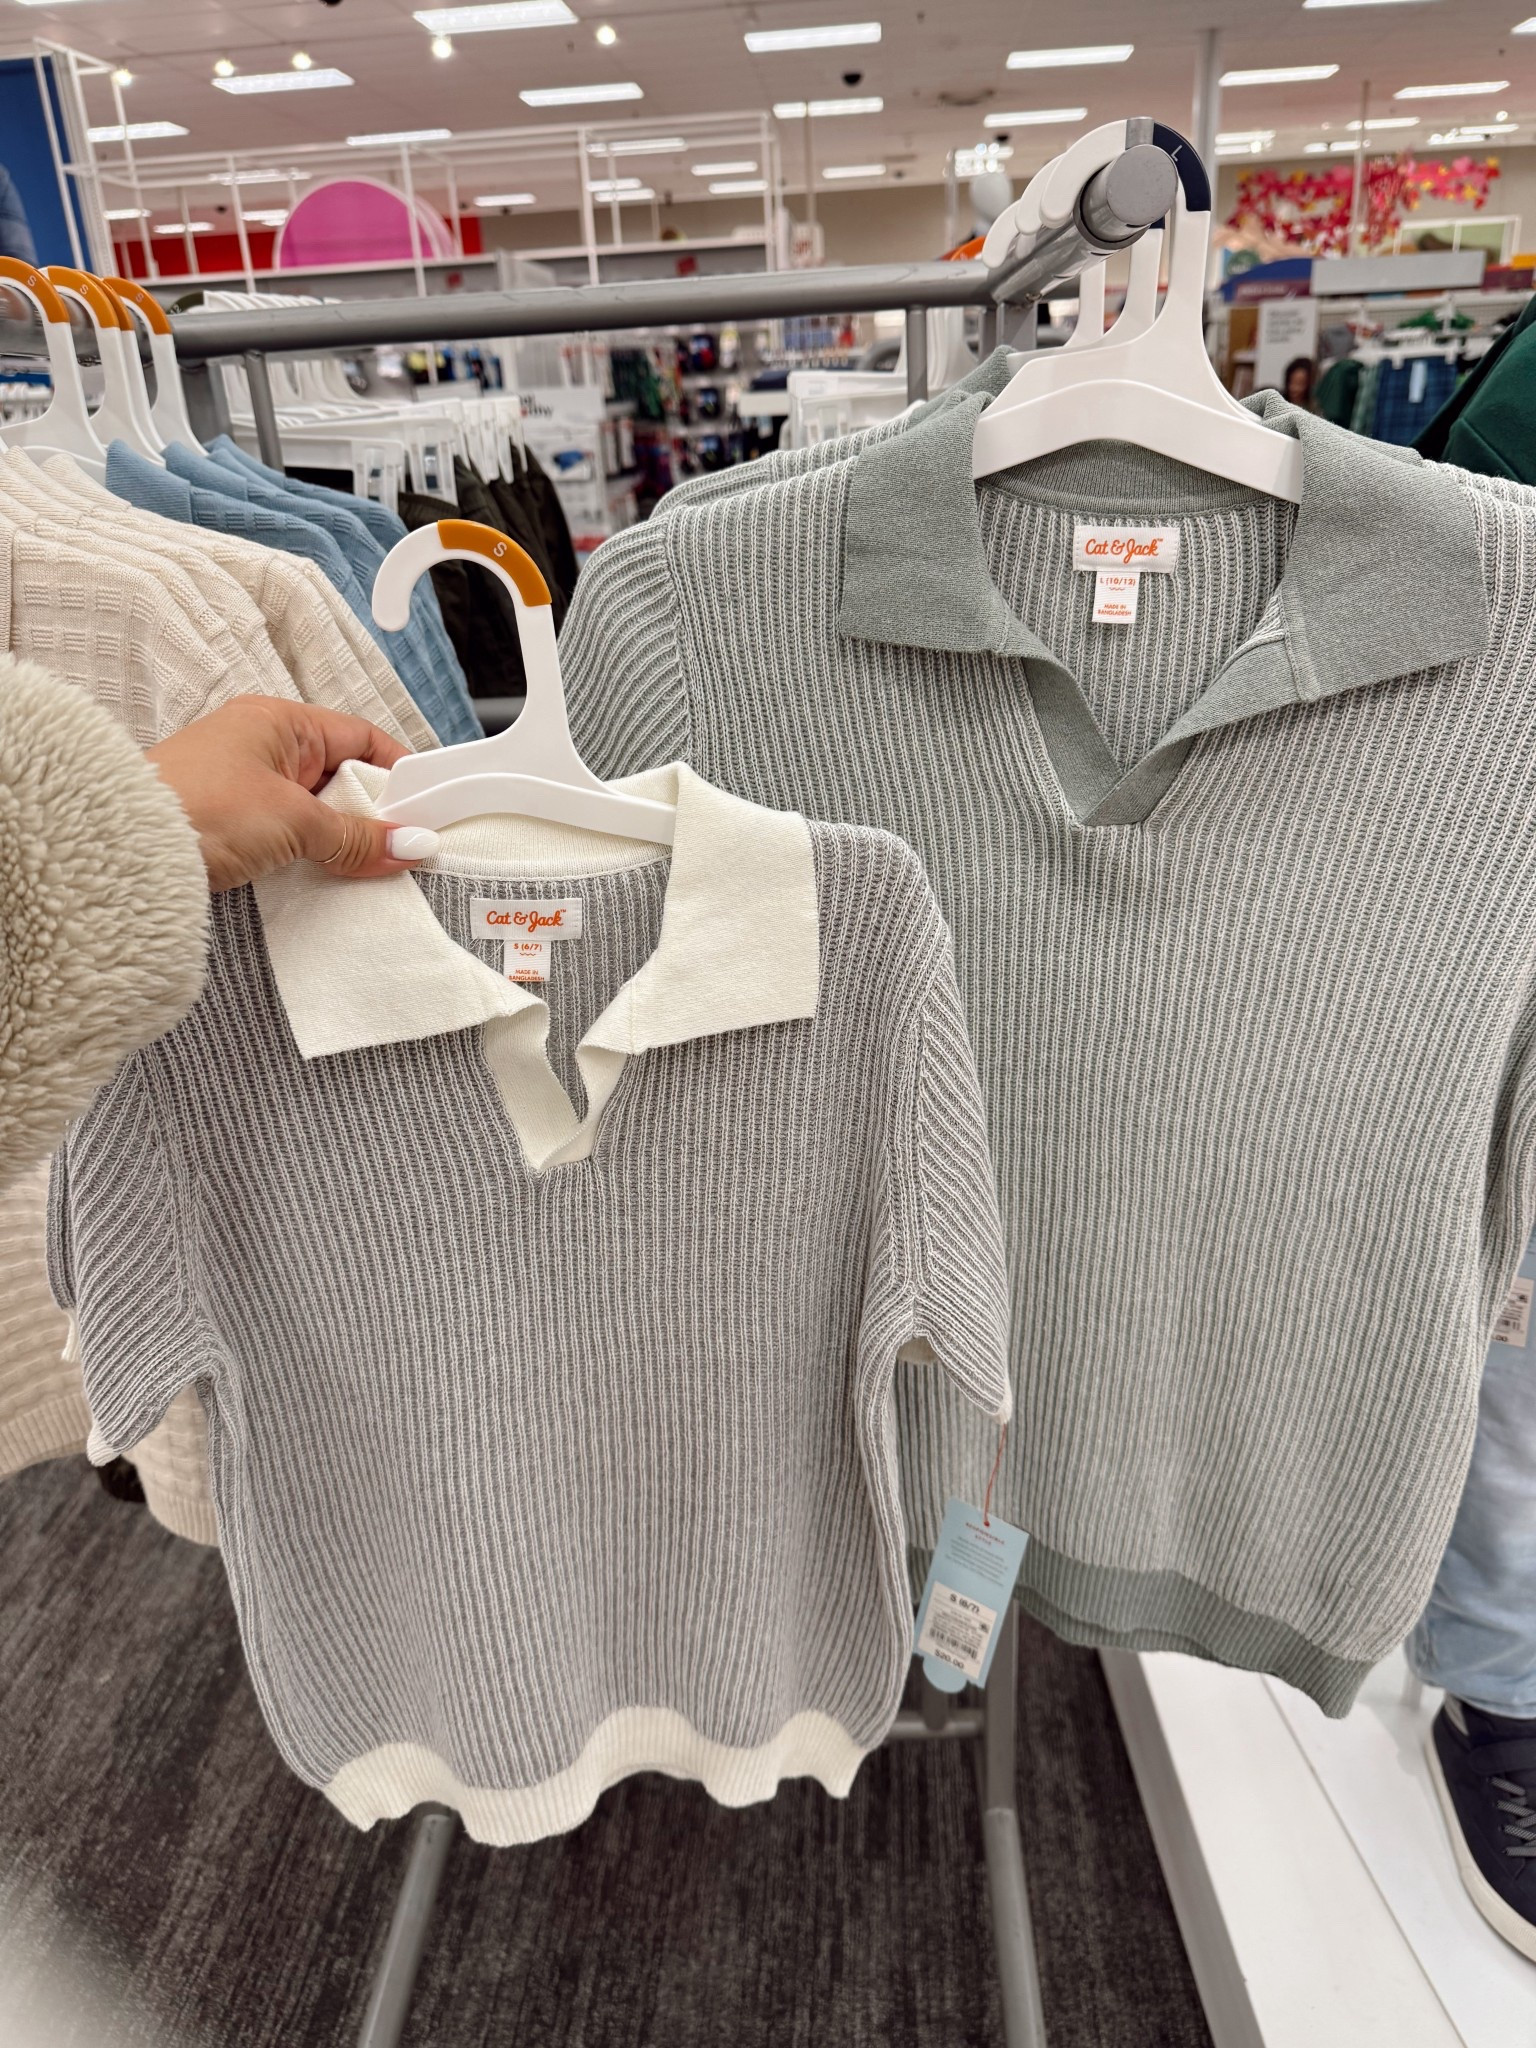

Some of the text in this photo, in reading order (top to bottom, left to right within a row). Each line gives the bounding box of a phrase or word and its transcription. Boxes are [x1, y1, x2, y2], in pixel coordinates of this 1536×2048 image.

[1171, 145, 1183, 162] L
[27, 275, 37, 287] S
[79, 283, 89, 295] S
[135, 291, 145, 303] S
[493, 541, 508, 558] S
[1085, 538, 1109, 555] Cat
[1110, 539, 1126, 555] &
[1105, 577, 1136, 586] (10/12)
[486, 910, 512, 925] Cat
[513, 911, 528, 925] &
[521, 943, 543, 952] (6/7)
[949, 1593, 980, 1613] S (6/7)
[934, 1649, 965, 1669] $20.00
